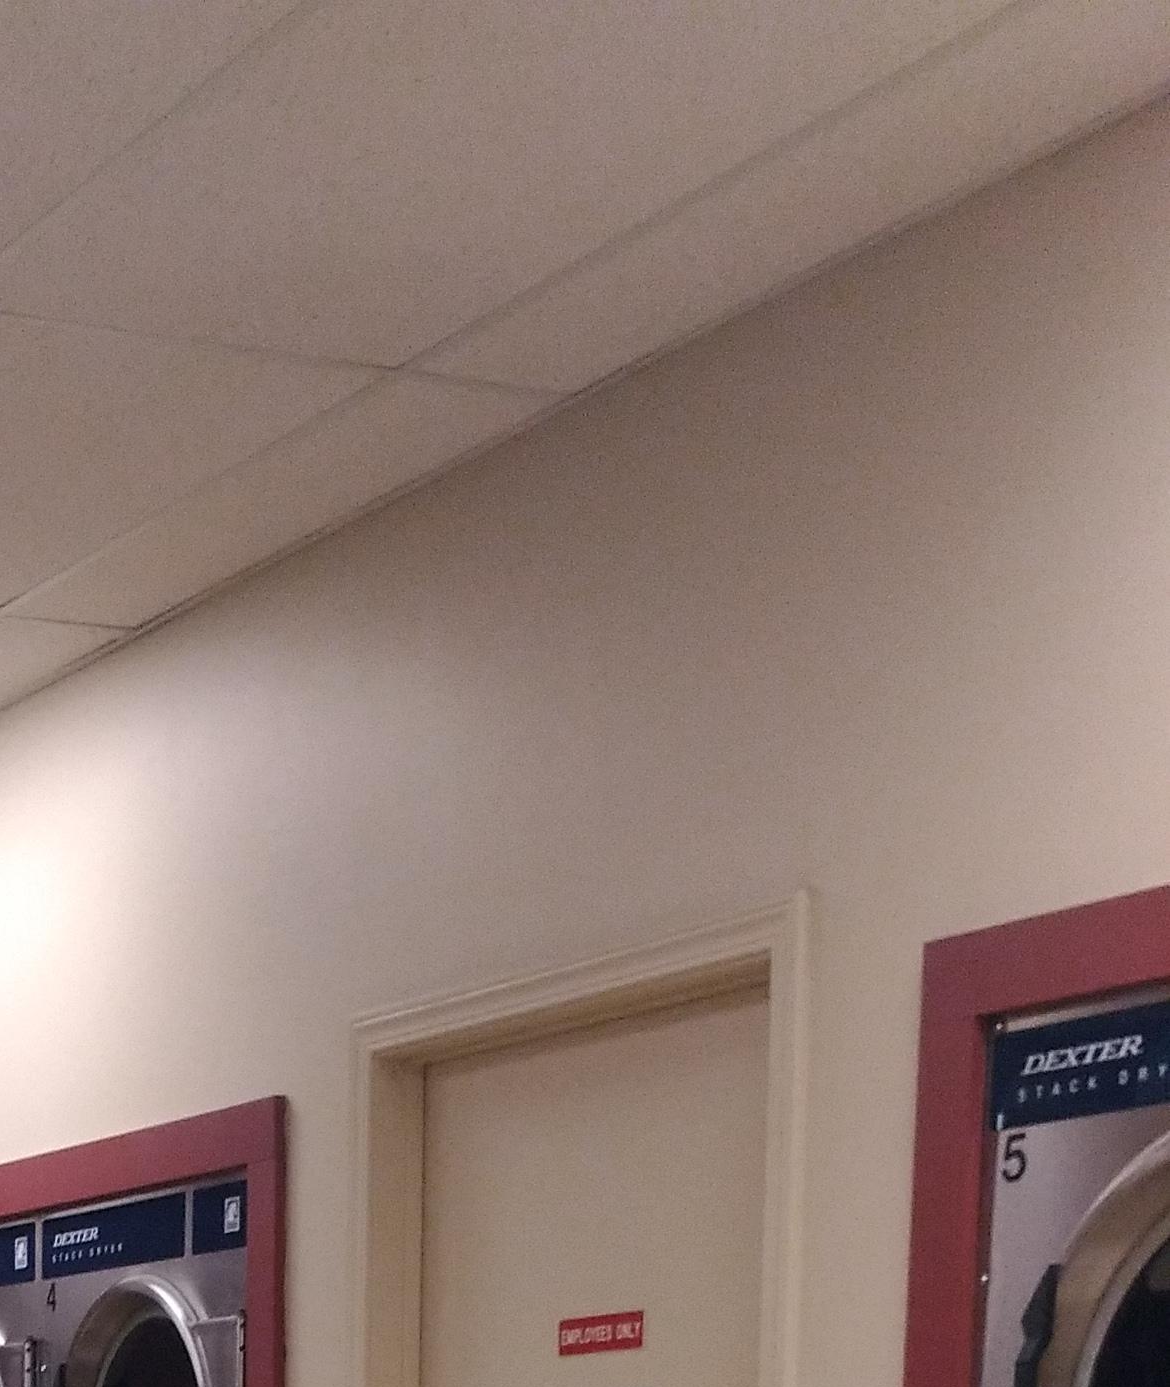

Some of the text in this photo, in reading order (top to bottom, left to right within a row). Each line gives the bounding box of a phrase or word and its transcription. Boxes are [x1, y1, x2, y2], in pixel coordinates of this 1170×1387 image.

[1020, 1033, 1144, 1077] DEXTER
[1017, 1075, 1099, 1104] STACK
[1001, 1132, 1027, 1183] 5
[52, 1226, 100, 1248] DEXTER
[46, 1282, 57, 1312] 4
[616, 1321, 641, 1340] ONLY
